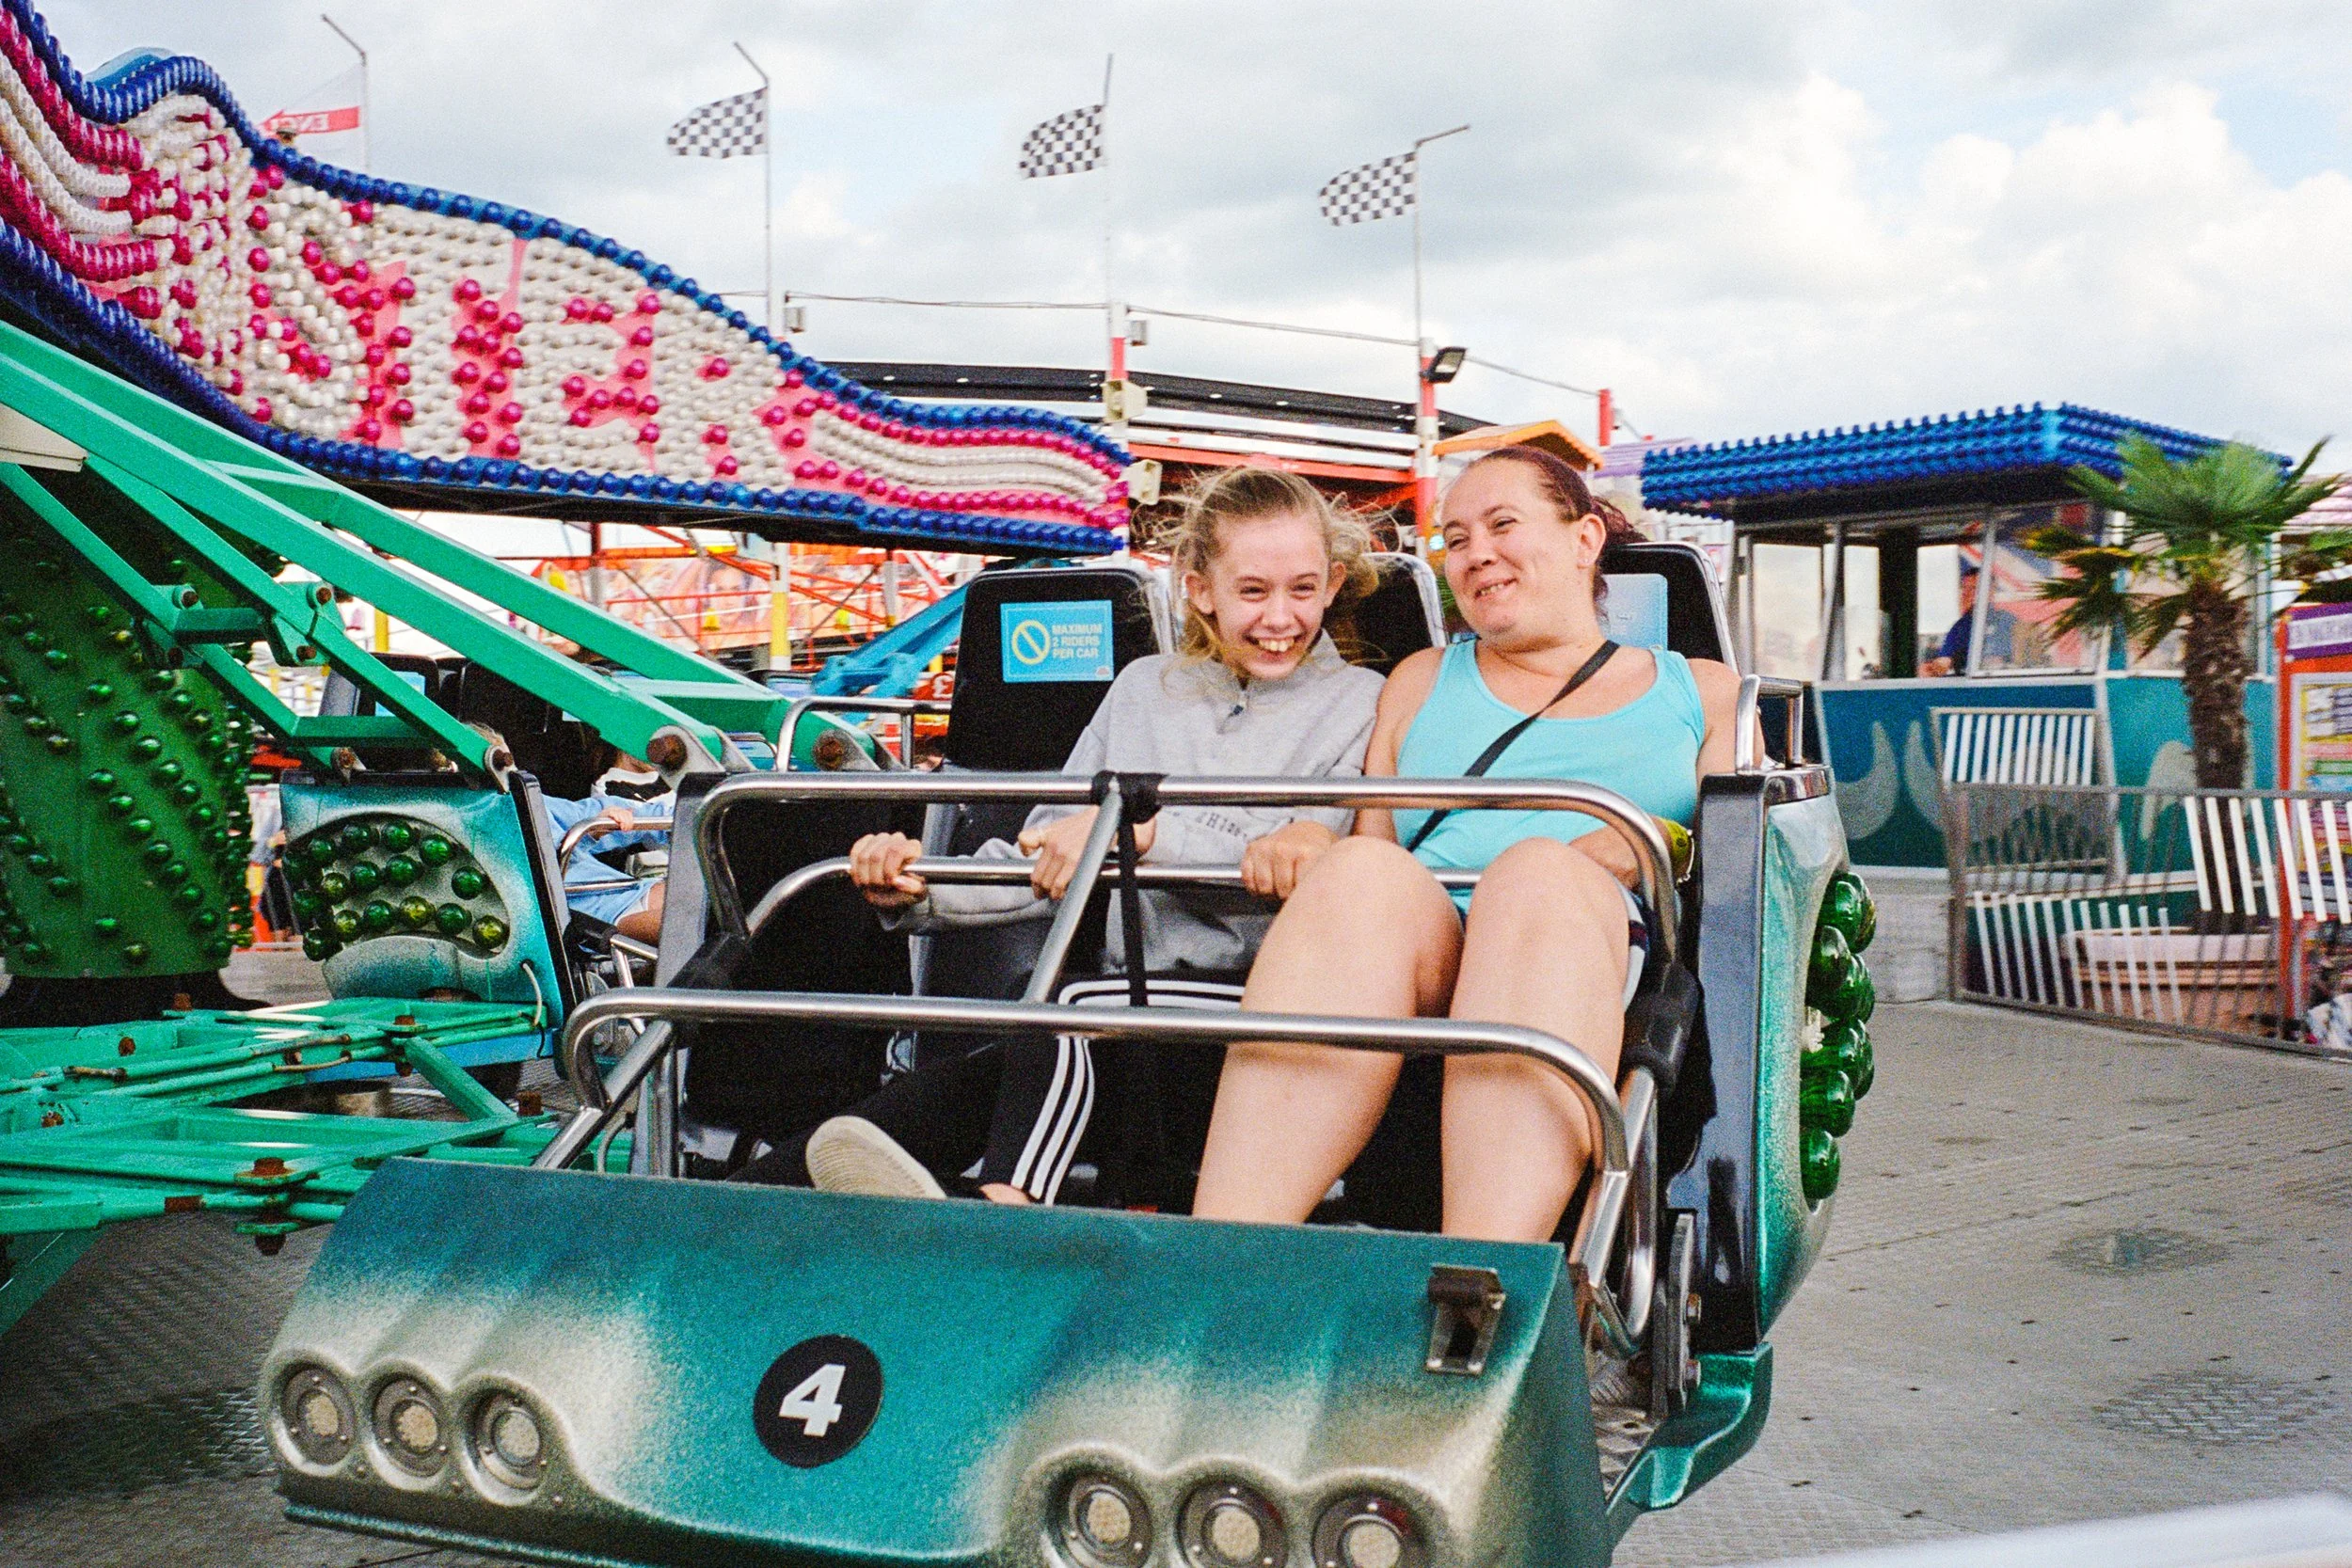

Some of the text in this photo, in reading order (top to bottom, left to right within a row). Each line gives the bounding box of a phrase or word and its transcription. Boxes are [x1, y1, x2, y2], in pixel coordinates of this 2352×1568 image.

[1051, 624, 1103, 635] MAXIMUM
[1052, 636, 1100, 647] 2 RIDERS
[1052, 647, 1100, 658] PER CAR
[778, 1363, 847, 1437] 4
